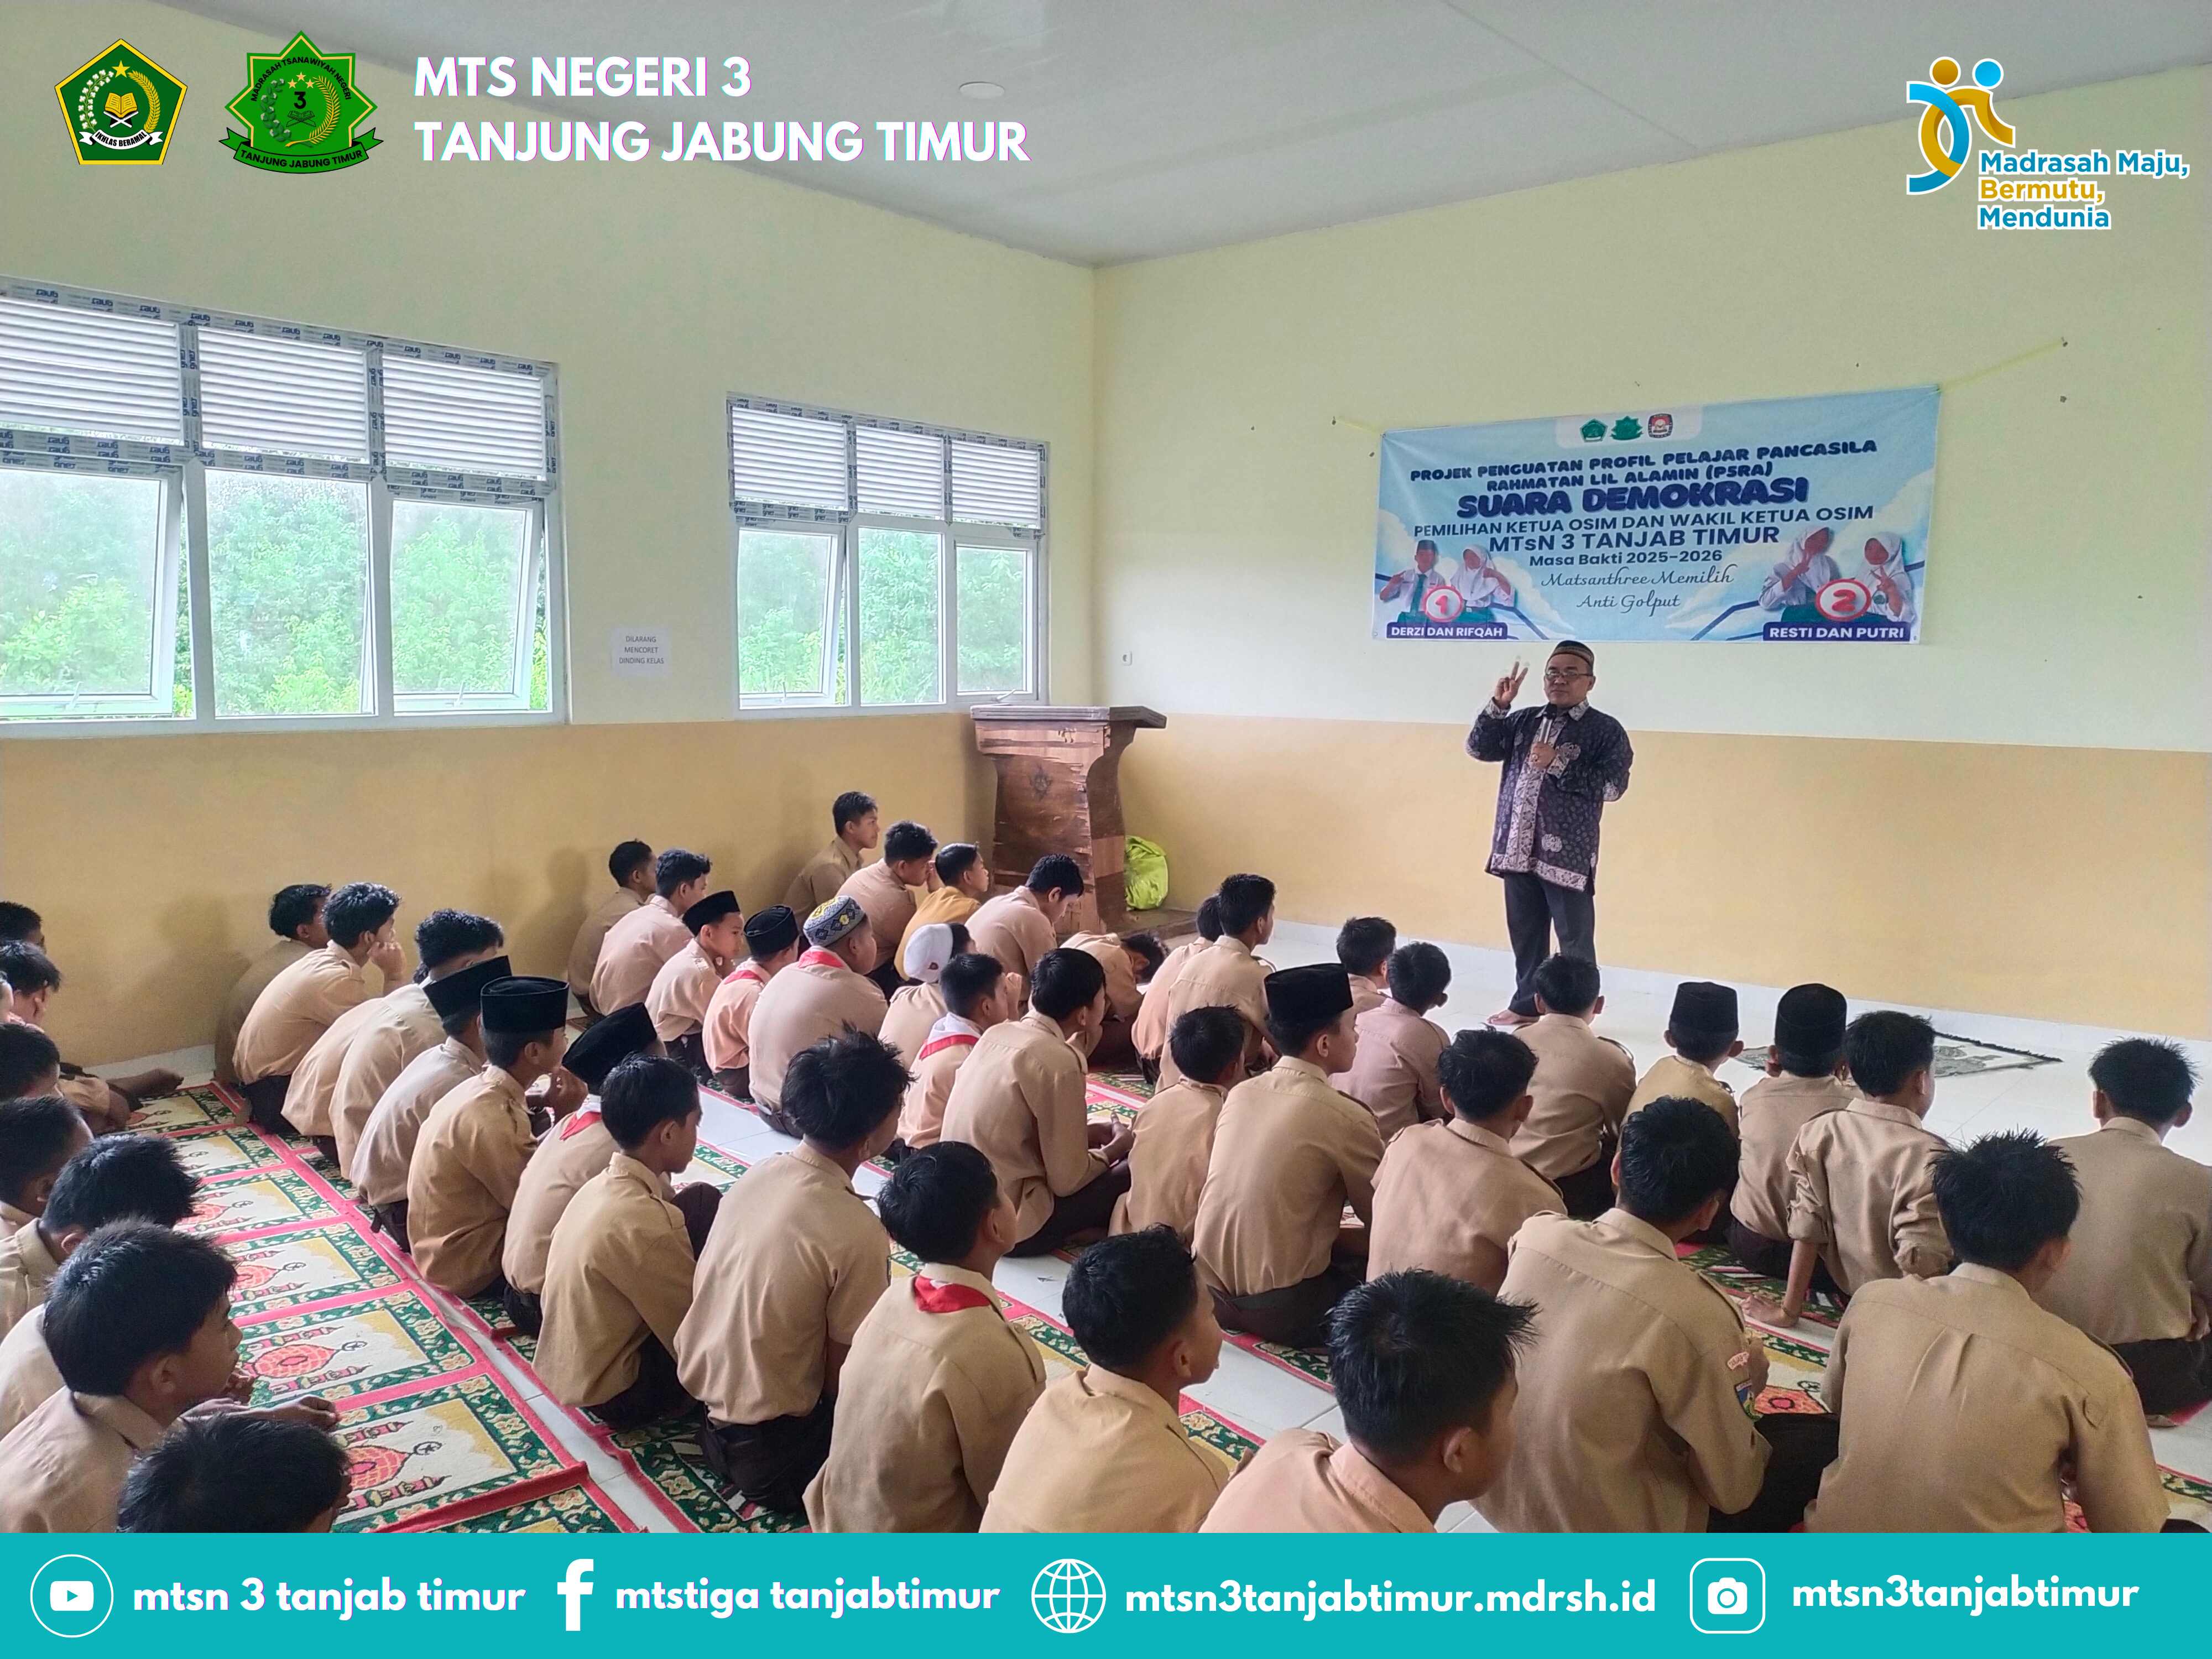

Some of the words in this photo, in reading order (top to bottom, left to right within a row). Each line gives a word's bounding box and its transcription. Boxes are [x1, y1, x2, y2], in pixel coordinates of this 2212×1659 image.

[1411, 467, 1472, 481] PROJEK
[1478, 460, 1583, 477] PENGUATAN
[1589, 455, 1656, 470] PROFIL
[1663, 448, 1750, 465] PELAJAR
[1756, 440, 1877, 460] PANCASILA
[1486, 475, 1584, 492] RAHMATAN
[1590, 473, 1618, 486] LIL
[1625, 467, 1699, 483] ALAMIN
[1705, 461, 1773, 479] (P5RA)
[1456, 490, 1573, 519] SUARA
[1582, 477, 1810, 512] DEMOKRASI
[1414, 521, 1502, 537] PEMILIHAN
[1506, 519, 1564, 534] KETUA
[1568, 516, 1617, 531] OSIM
[1622, 515, 1664, 529] DAN
[1670, 512, 1735, 526] WAKIL
[1741, 508, 1811, 524] KETUA
[1815, 505, 1874, 521] OSIM
[1489, 535, 1555, 552] MTsN
[1561, 533, 1574, 550] 3
[1582, 530, 1686, 548] TANJAB
[1692, 526, 1780, 545] TIMUR
[1529, 555, 1575, 566] Masa
[1578, 552, 1622, 565] Bakti
[1541, 566, 1650, 587] Matsanthree
[1652, 564, 1738, 585] Memilih
[1435, 595, 1448, 614] 1
[1576, 593, 1616, 608] Anti
[1620, 589, 1681, 617] Golput
[1831, 588, 1857, 612] 2
[1391, 627, 1425, 637] DERZI
[1427, 627, 1453, 637] DAN
[1456, 627, 1503, 638] RIFQAH
[1769, 628, 1813, 638] RESTI
[1815, 628, 1852, 638] DAN
[1856, 628, 1905, 638] PUTRI
